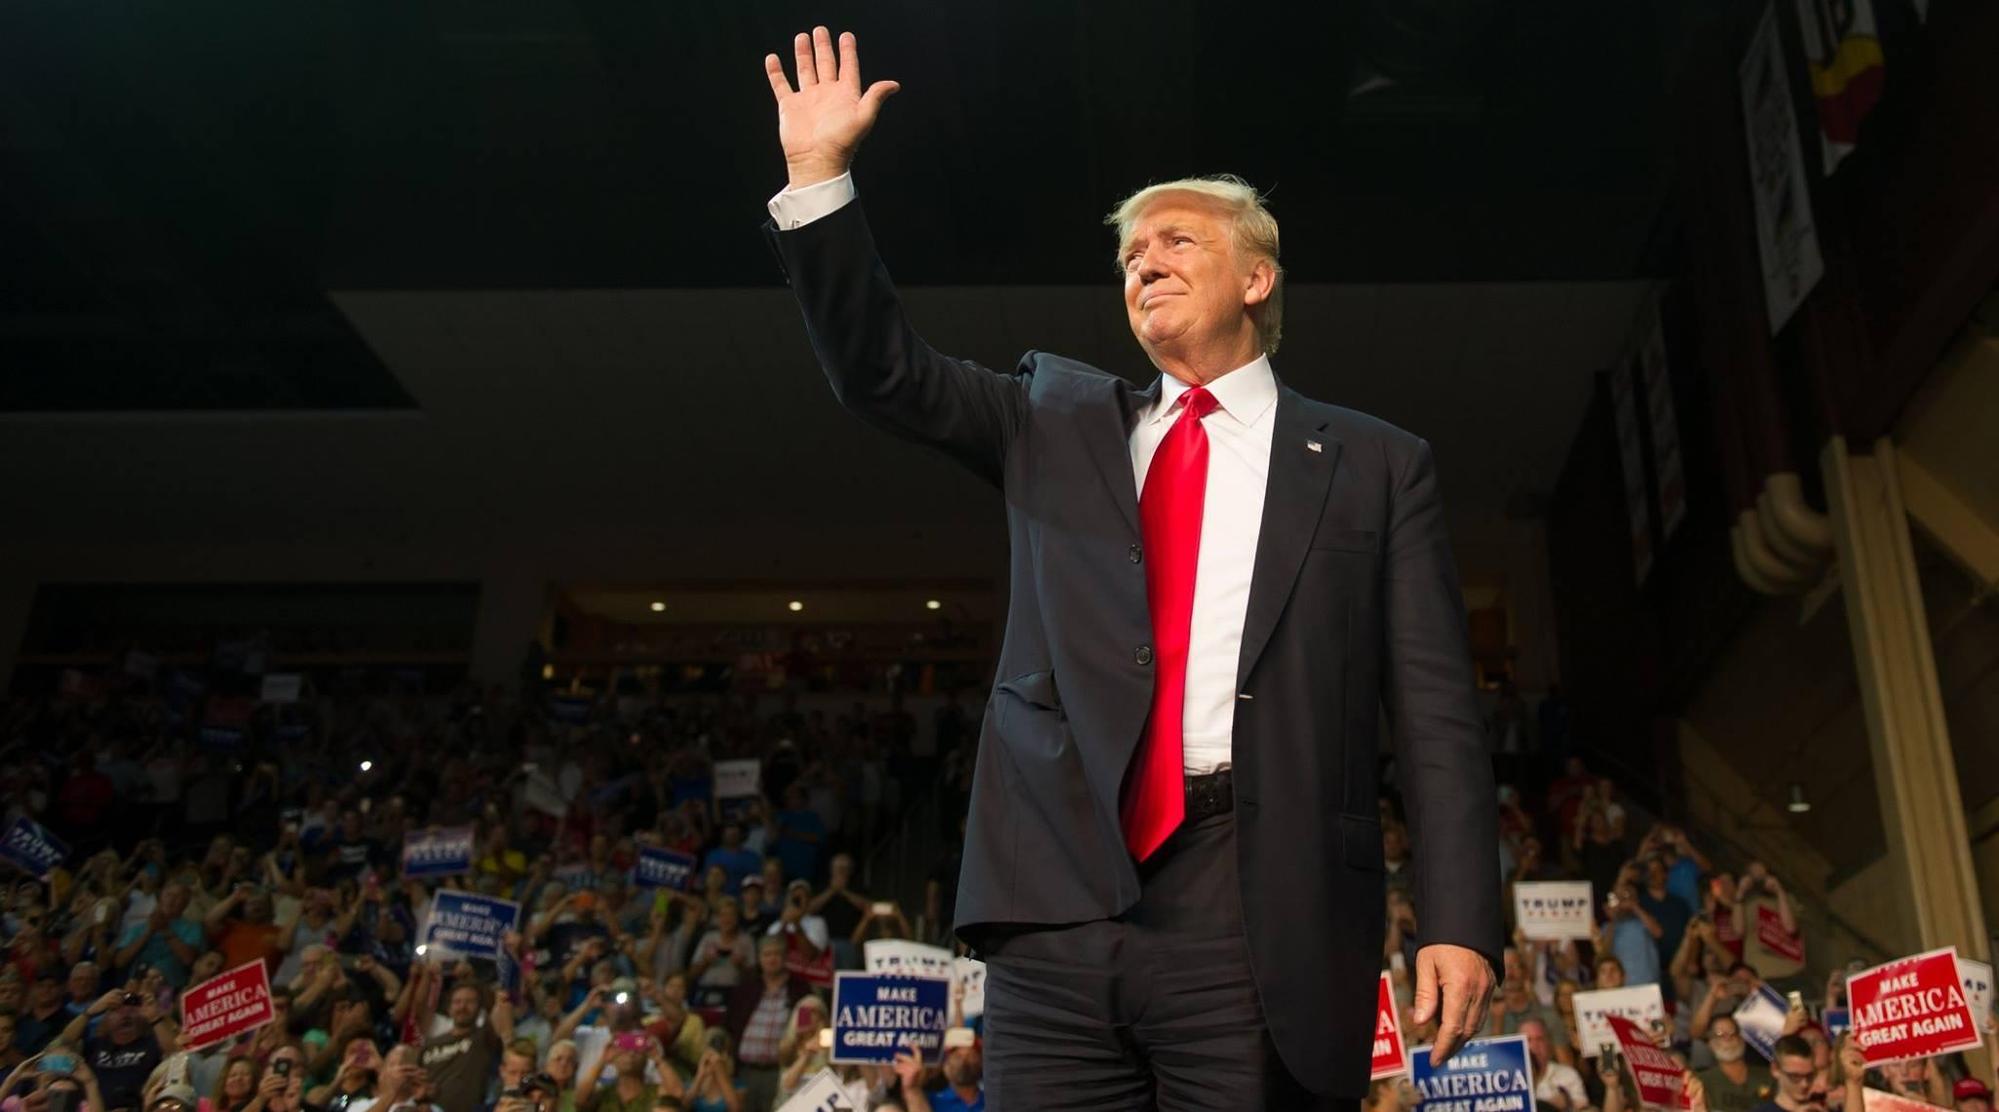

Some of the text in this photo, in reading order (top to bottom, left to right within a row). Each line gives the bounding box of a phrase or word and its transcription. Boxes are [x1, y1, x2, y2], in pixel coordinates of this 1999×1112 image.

[1522, 898, 1587, 909] TRUMP
[206, 980, 237, 999] MAKE
[876, 986, 918, 1002] MAKE
[1879, 972, 1920, 995] MAKE
[186, 984, 268, 1027] AMERICA
[227, 1002, 264, 1024] AGAIN
[1854, 984, 1965, 1029] AMERICA
[837, 1005, 946, 1030] AMERICA
[843, 1031, 939, 1049] GREAT AGAIN
[1859, 1023, 1908, 1048] GREAT
[1912, 1012, 1965, 1038] AGAIN
[1447, 1053, 1488, 1071] MAKE
[1415, 1068, 1528, 1100] AMERICA
[1474, 1094, 1524, 1112] AGAIN
